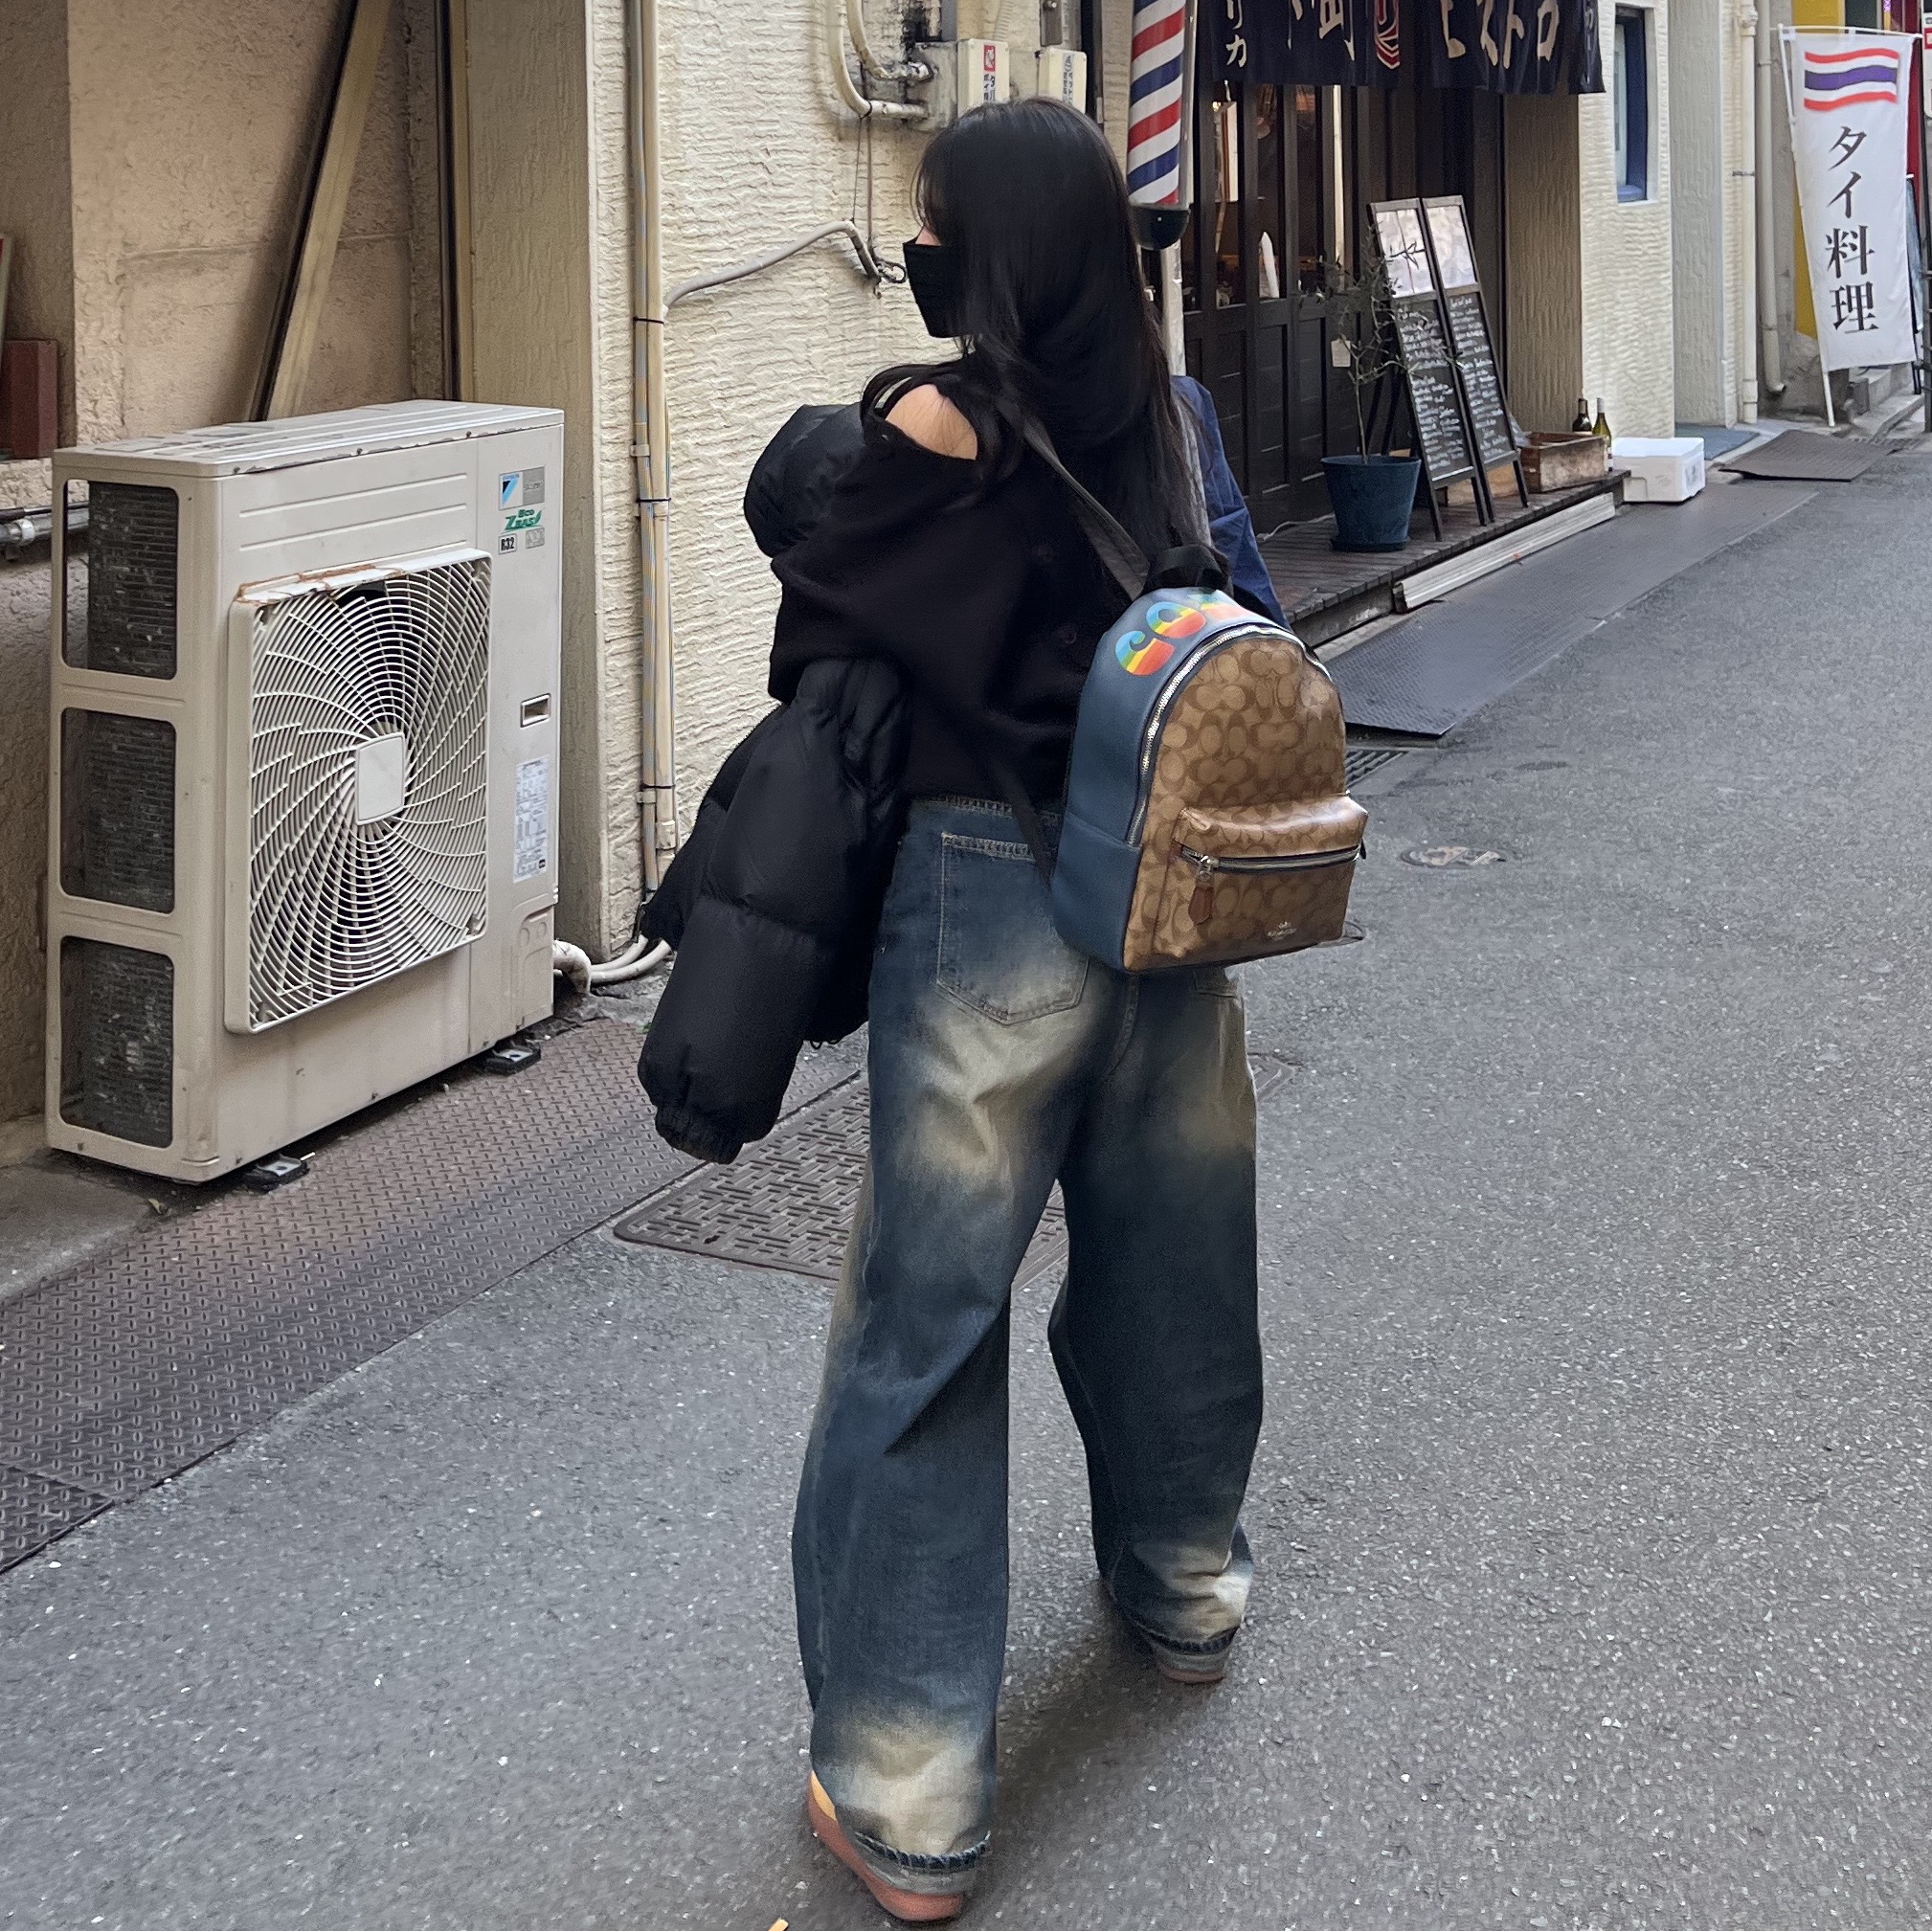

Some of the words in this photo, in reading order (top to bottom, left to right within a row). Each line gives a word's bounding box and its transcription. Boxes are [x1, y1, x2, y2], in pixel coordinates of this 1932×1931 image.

[1826, 126, 1879, 335] タイ料理
[501, 536, 515, 551] R32
